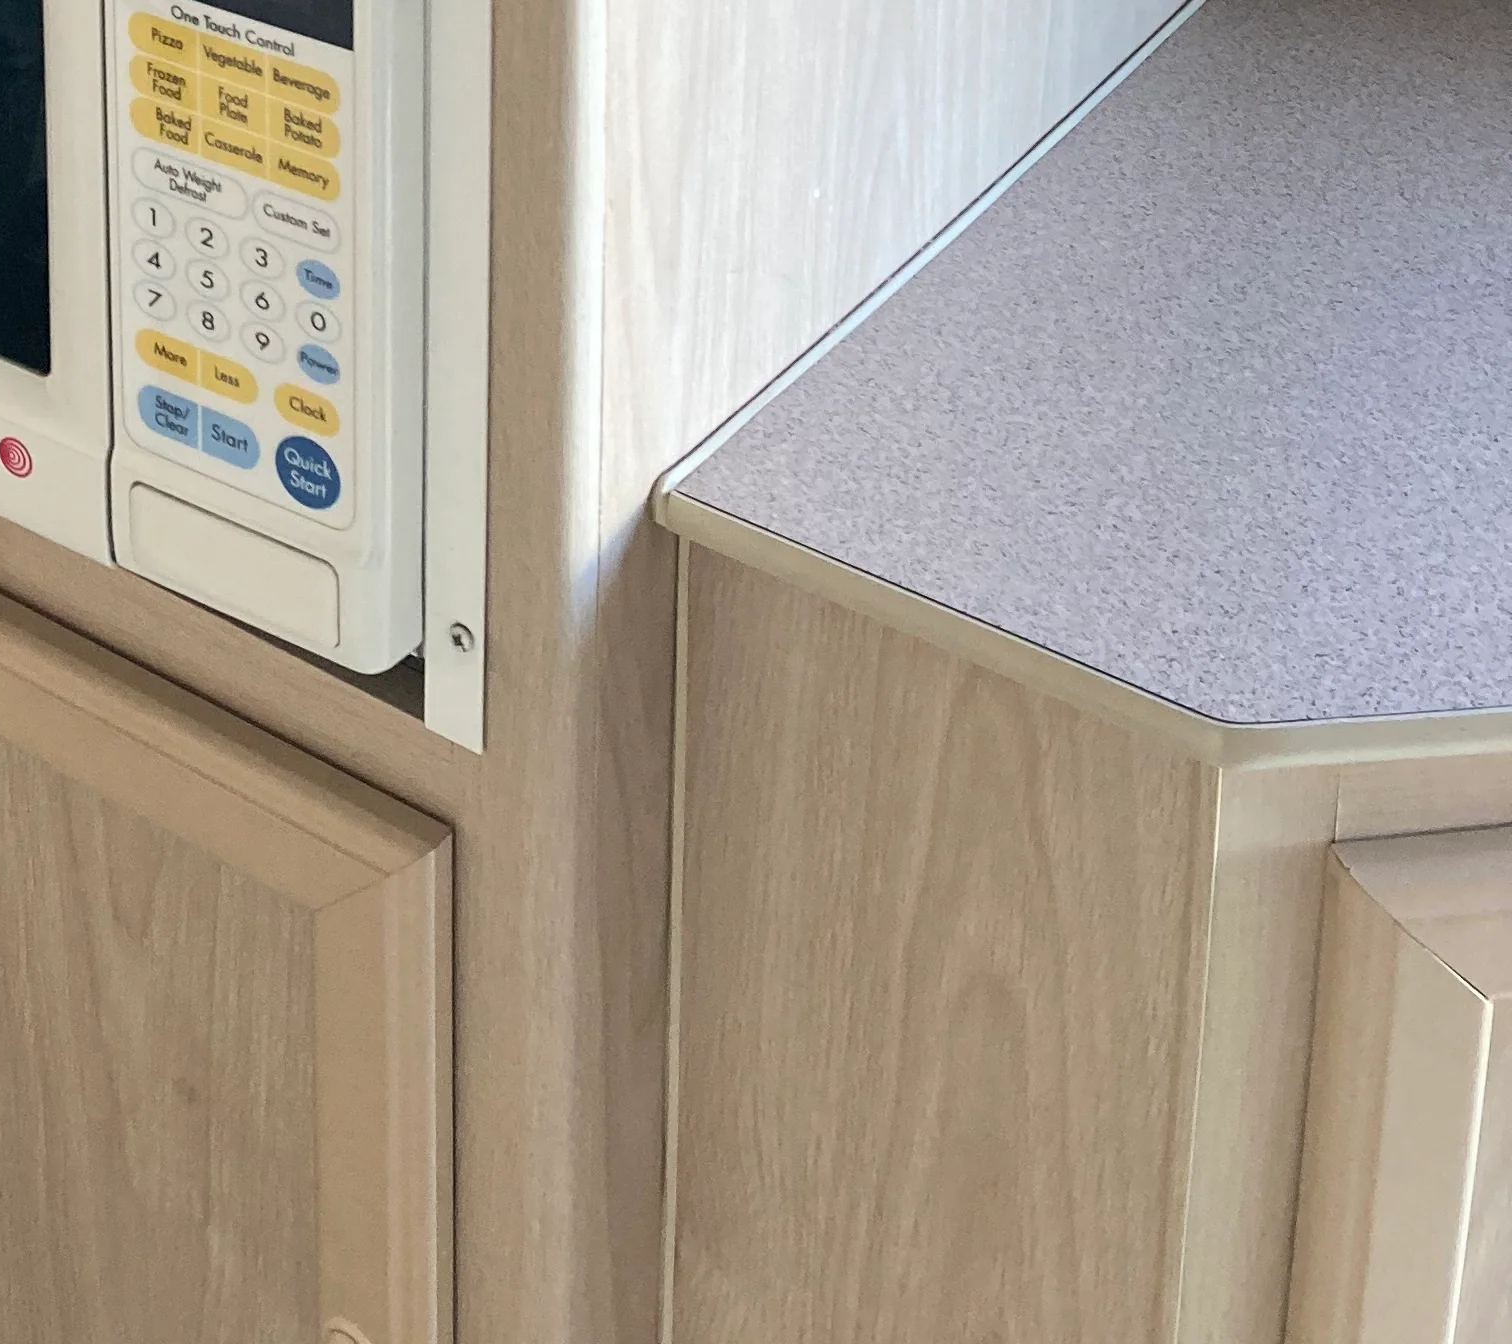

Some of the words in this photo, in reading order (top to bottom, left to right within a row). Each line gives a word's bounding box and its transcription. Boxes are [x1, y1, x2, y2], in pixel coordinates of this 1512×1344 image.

[151, 27, 183, 50] Pizza
[170, 5, 199, 26] One
[203, 14, 241, 39] Touch
[245, 29, 295, 56] Control
[203, 45, 263, 77] Vegetable
[147, 62, 187, 87] Frozen
[273, 67, 330, 101] Beverage
[152, 80, 182, 101] Food
[218, 86, 249, 109] Food
[156, 107, 192, 131] Baked
[219, 102, 249, 123] Plate
[284, 108, 322, 133] Baked
[160, 123, 189, 145] Food
[284, 124, 323, 149] Potato
[204, 132, 263, 163] Casserole
[154, 159, 180, 178] Auto
[182, 167, 223, 193] Weight
[278, 158, 329, 190] Memory
[170, 179, 207, 203] Defrost
[149, 207, 157, 227] 1
[263, 203, 308, 230] Custom
[312, 220, 331, 238] Set
[200, 227, 214, 248] 2
[147, 251, 162, 269] 4
[255, 248, 269, 268] 3
[200, 270, 214, 290] 5
[304, 267, 333, 290] Time
[148, 289, 162, 307] 7
[255, 292, 270, 310] 6
[202, 311, 214, 331] 8
[311, 312, 326, 332] 0
[256, 332, 270, 351] 9
[154, 342, 188, 367] More
[300, 351, 338, 376] Power
[214, 367, 240, 388] Less
[289, 396, 327, 422] Clock
[154, 413, 189, 436] Clear
[211, 424, 249, 452] Start
[284, 447, 333, 481] Quick
[290, 470, 327, 499] Start
